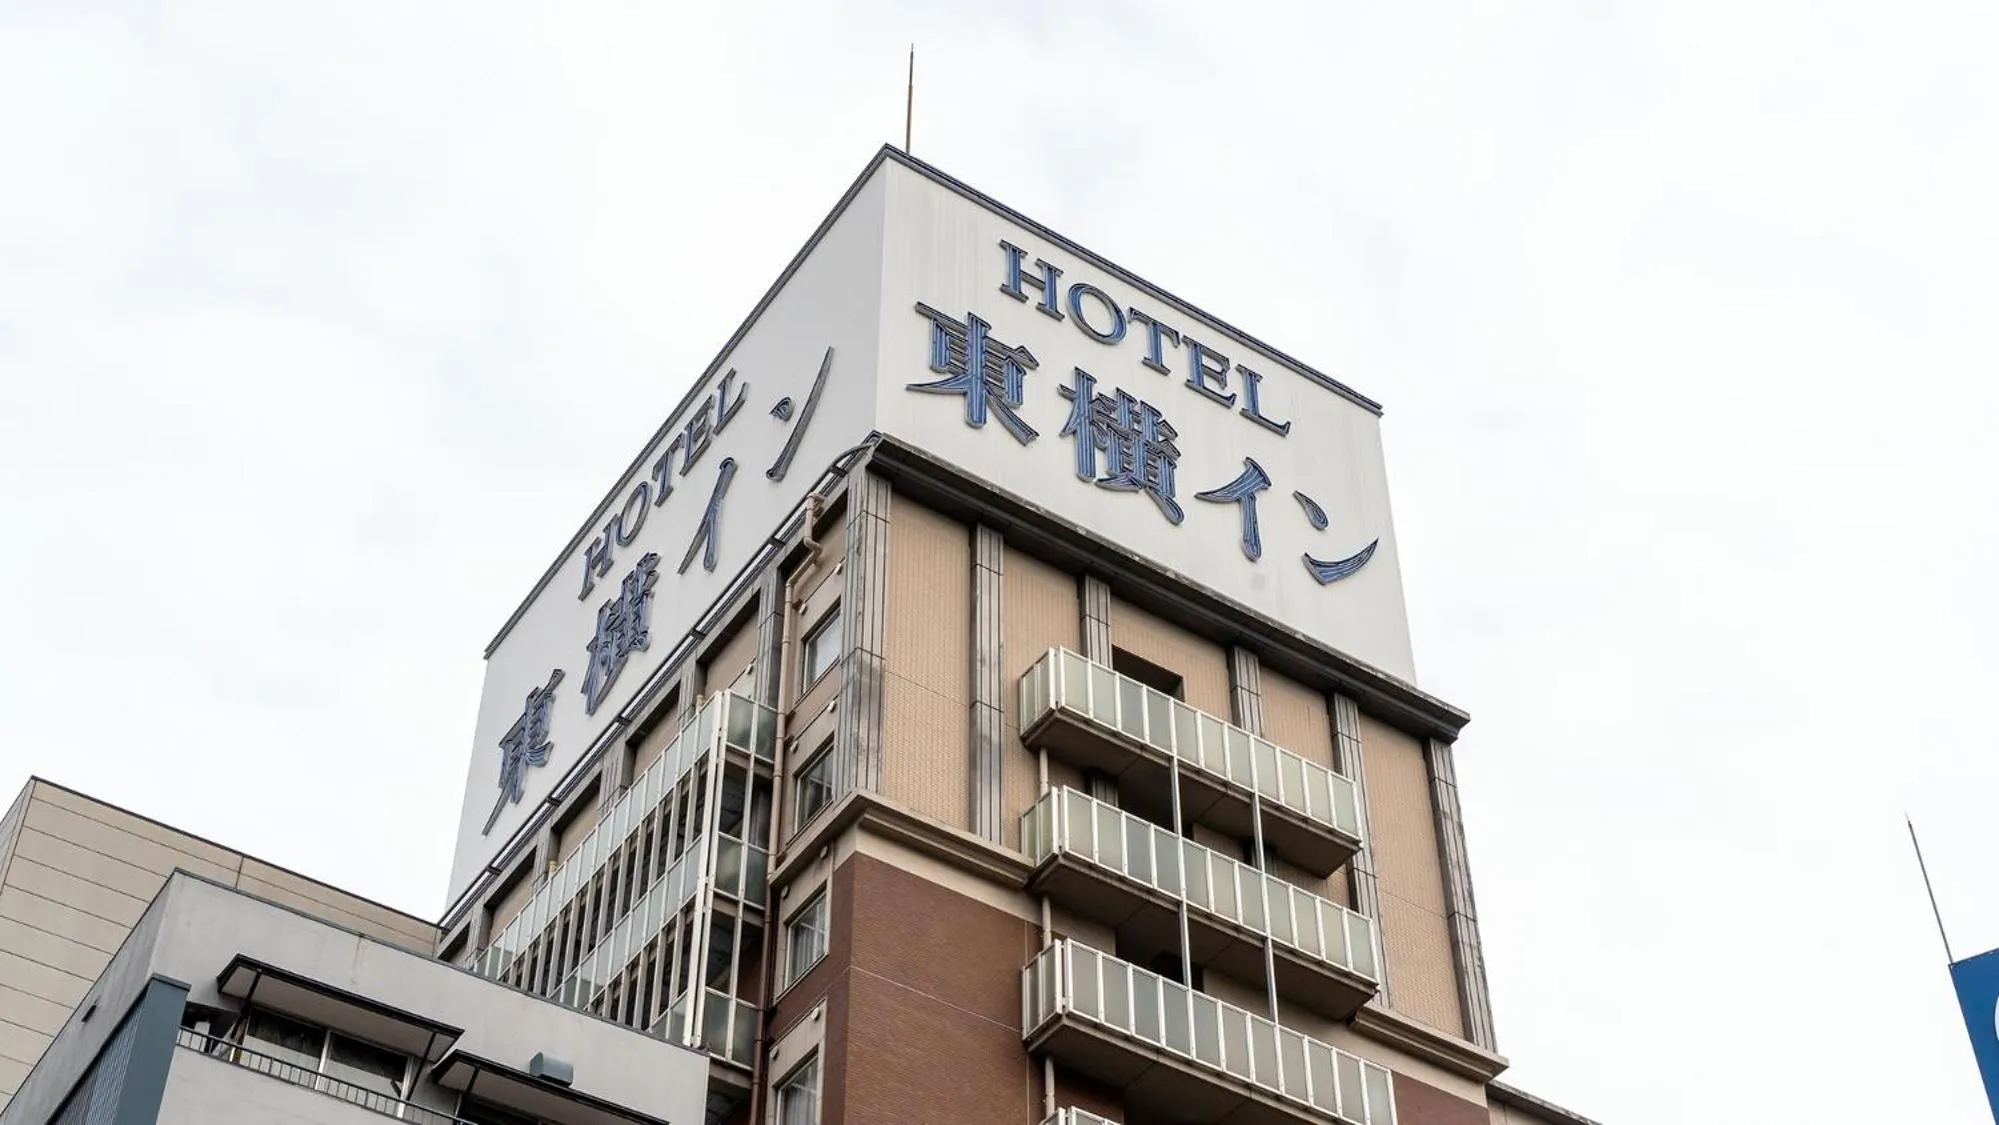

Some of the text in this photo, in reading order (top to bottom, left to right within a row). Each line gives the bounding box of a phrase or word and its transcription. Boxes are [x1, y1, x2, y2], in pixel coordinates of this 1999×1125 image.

[906, 301, 1379, 585] 東横イン
[999, 239, 1291, 437] HOTEL
[482, 345, 834, 836] 東横イン
[578, 368, 747, 601] HOTEL
